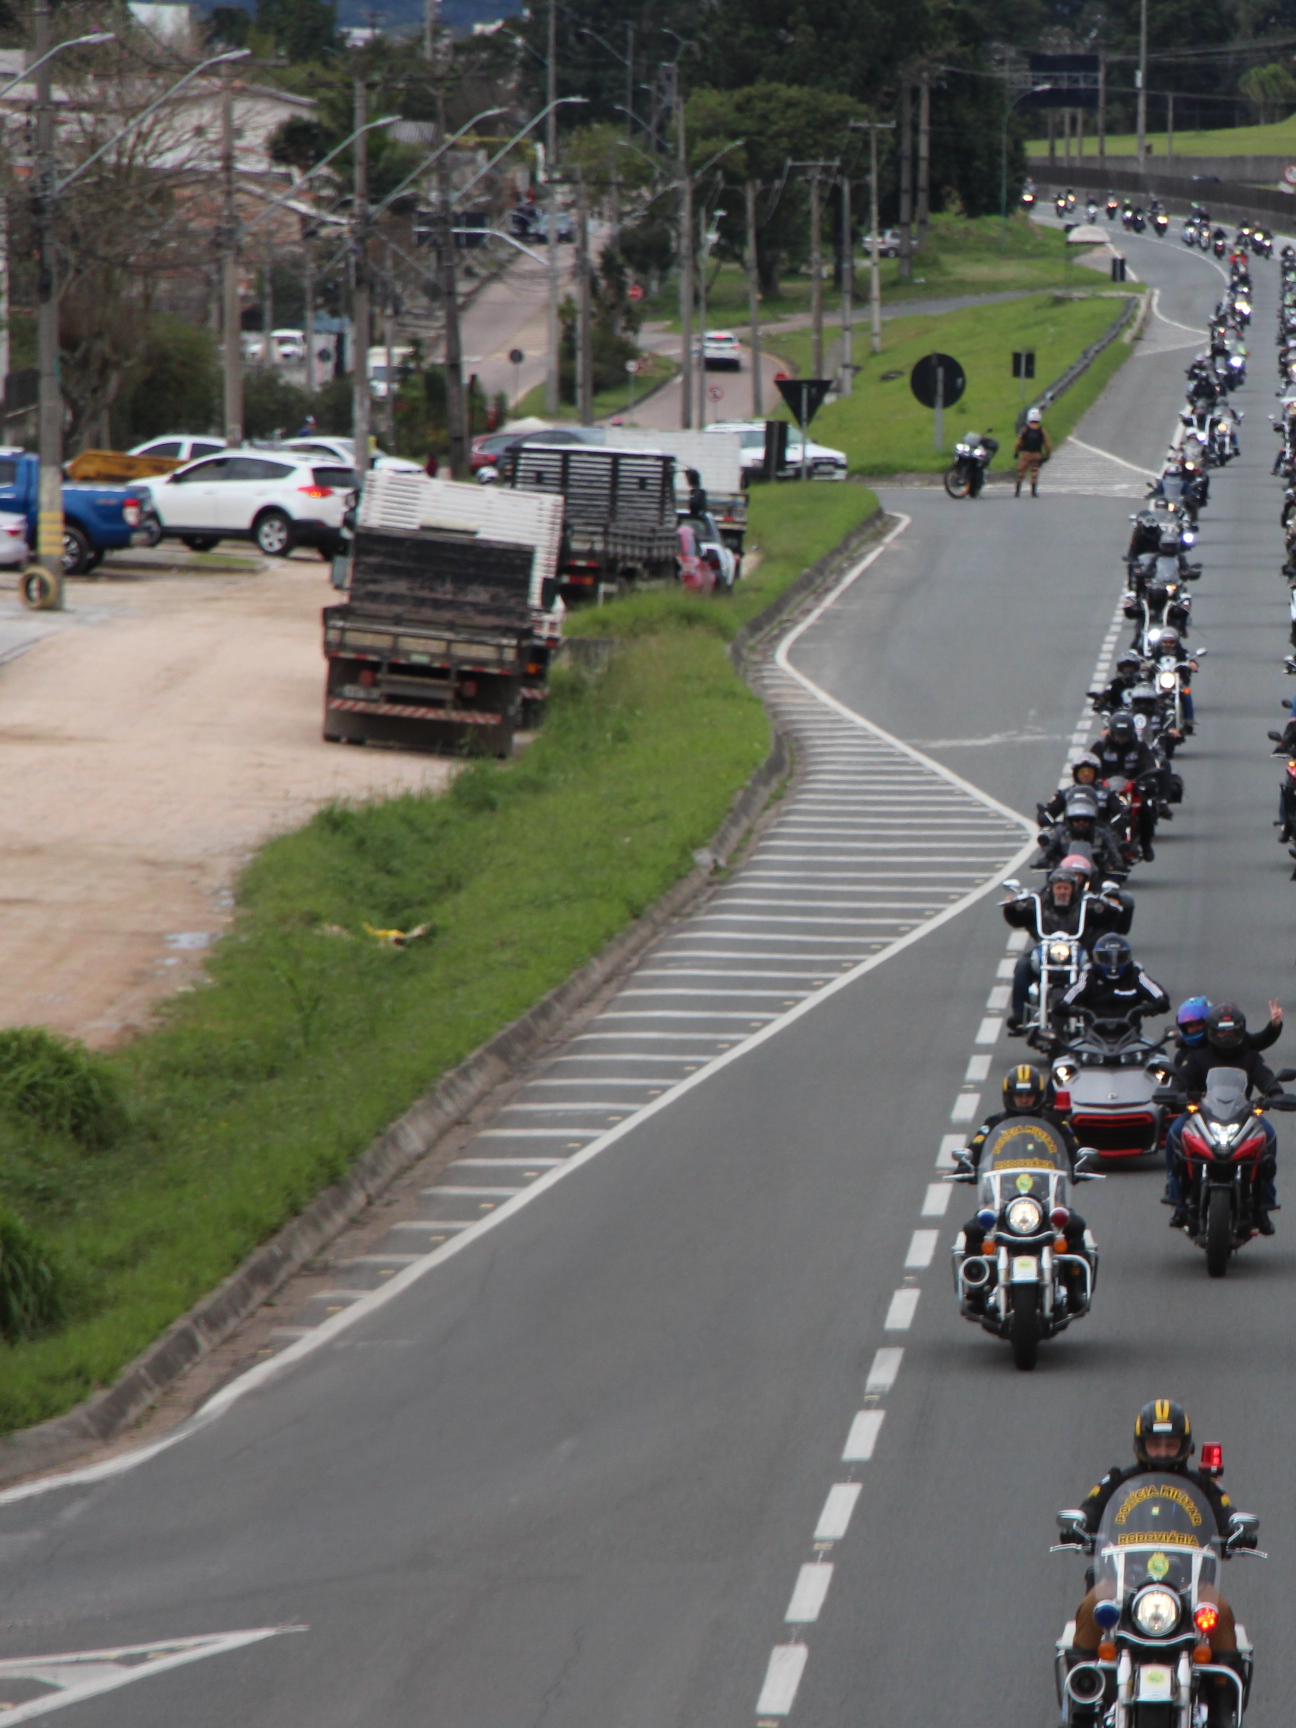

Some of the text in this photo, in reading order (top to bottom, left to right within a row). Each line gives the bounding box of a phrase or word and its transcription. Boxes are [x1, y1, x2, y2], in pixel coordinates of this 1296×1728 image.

[1114, 1484, 1203, 1527] POLÍCIA MILITAR
[1118, 1530, 1199, 1547] RODOVIÁRIA
